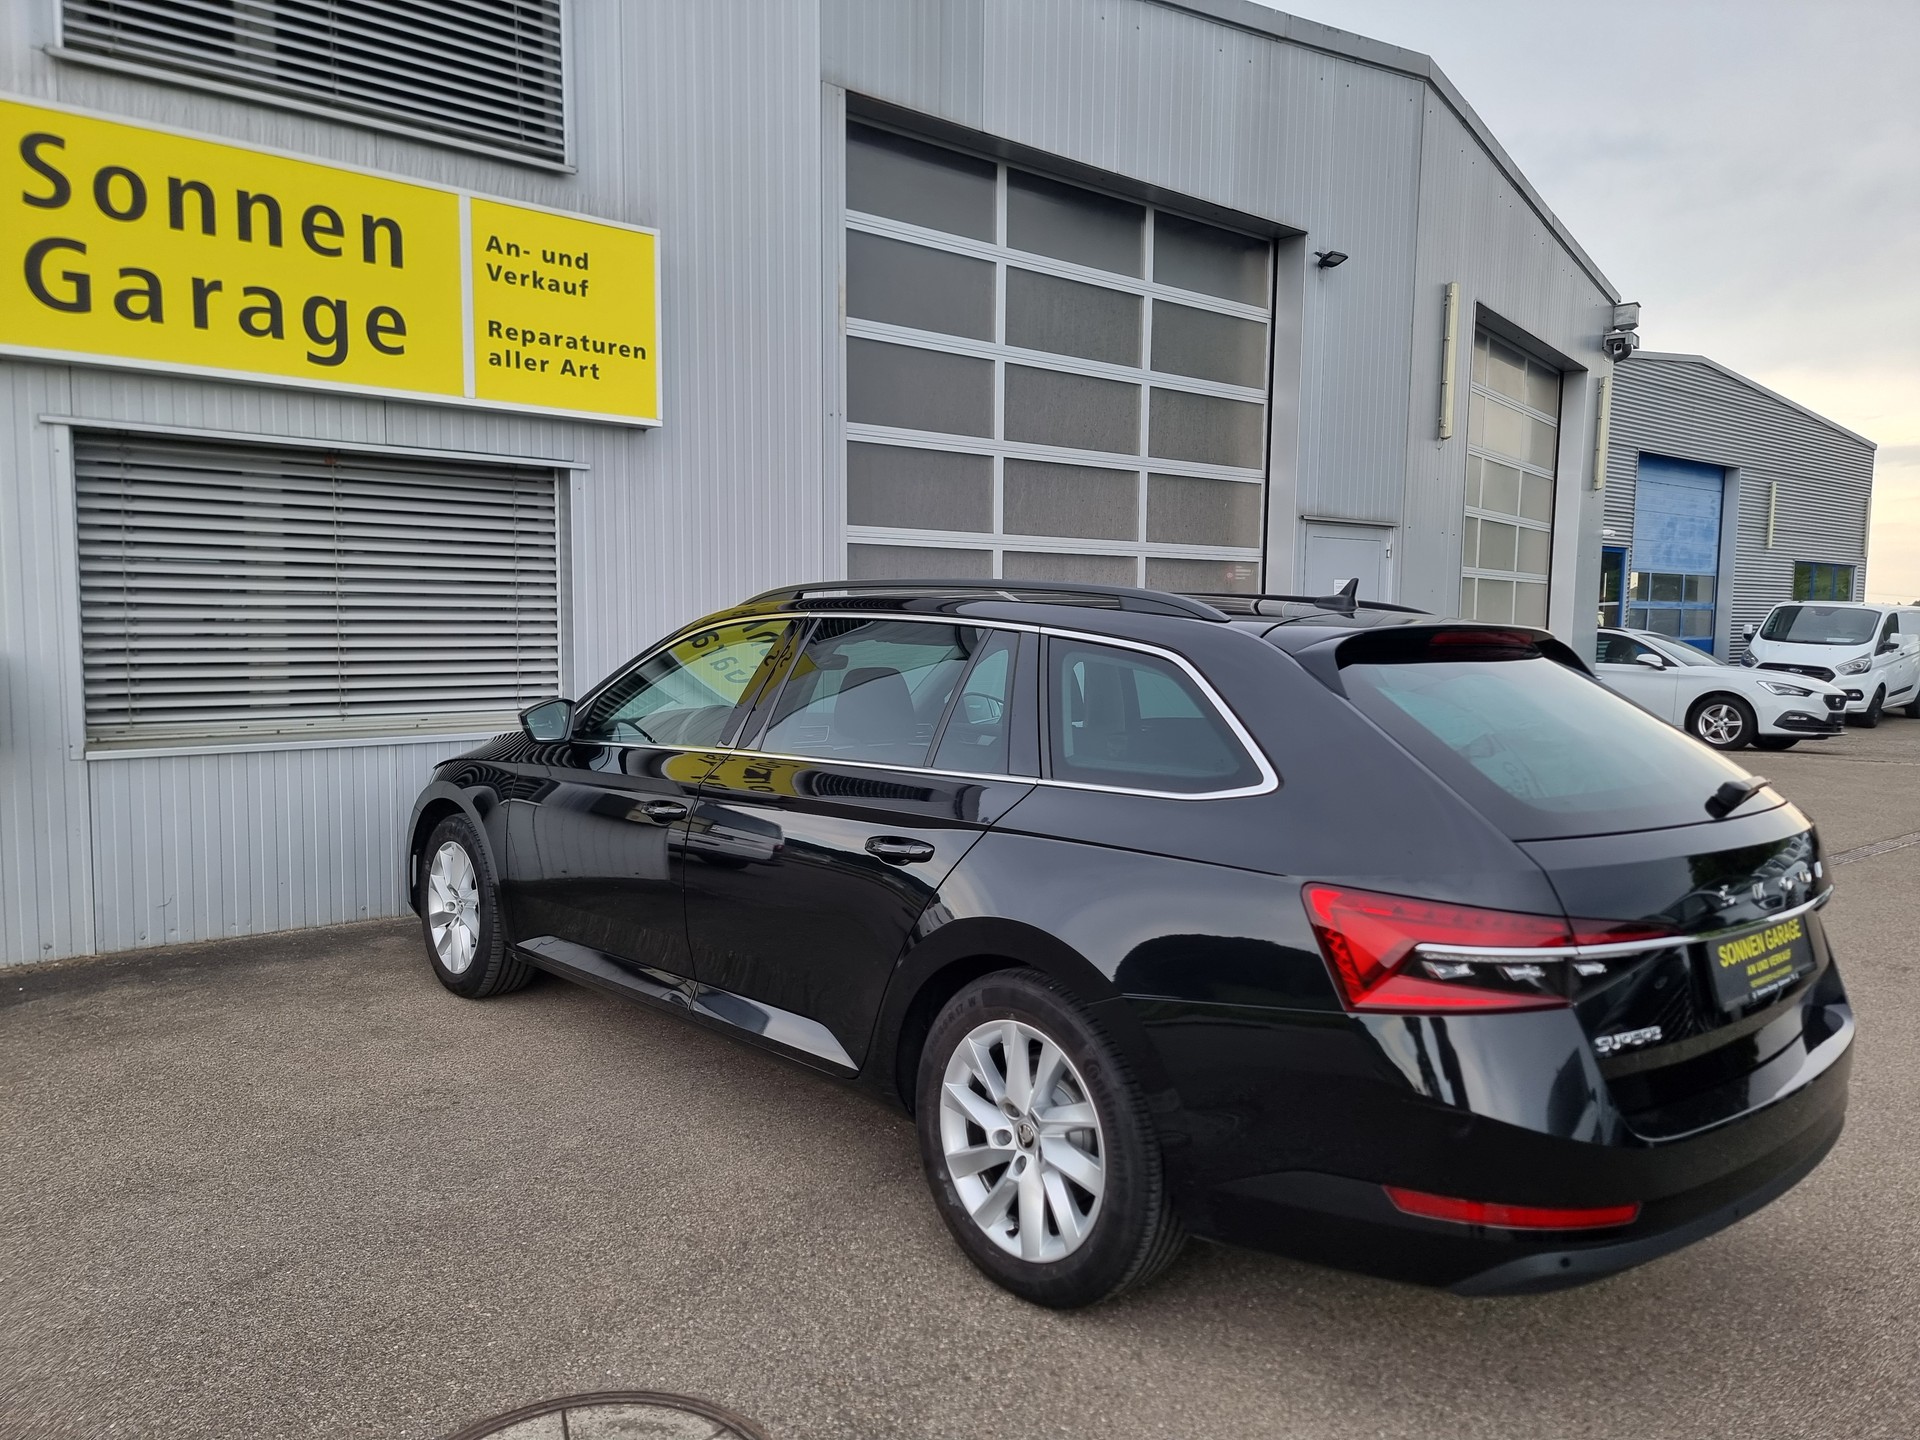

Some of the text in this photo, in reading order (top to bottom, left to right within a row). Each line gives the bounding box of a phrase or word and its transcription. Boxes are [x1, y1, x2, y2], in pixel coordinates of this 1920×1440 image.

[19, 132, 404, 269] Sonnen
[485, 235, 589, 271] An- und
[486, 262, 589, 298] Verkauf
[23, 236, 407, 367] Garage
[488, 319, 646, 360] Reparaturen
[488, 349, 600, 381] aller Art
[1718, 918, 1802, 968] SONNEN GARAGE
